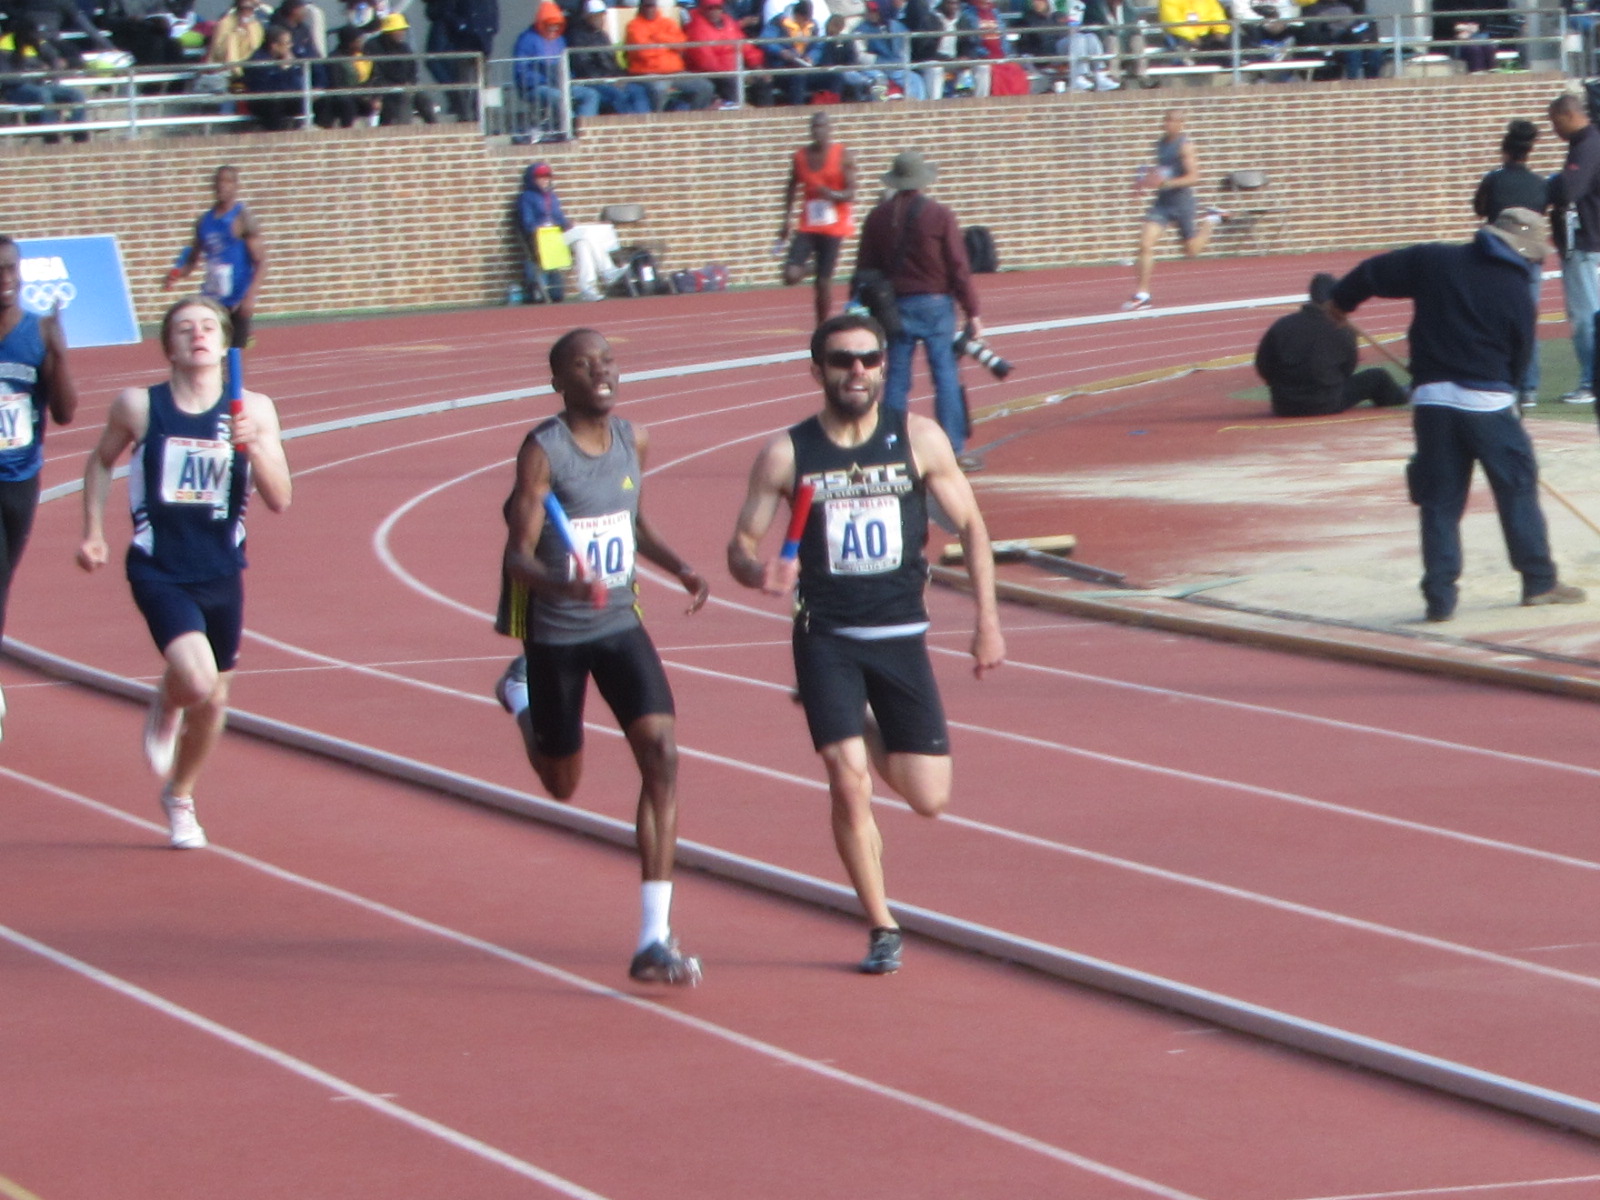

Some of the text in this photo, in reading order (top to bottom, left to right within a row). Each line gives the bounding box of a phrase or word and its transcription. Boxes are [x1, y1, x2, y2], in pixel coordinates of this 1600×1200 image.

[178, 456, 229, 491] AW
[829, 500, 855, 510] PENN
[573, 520, 599, 530] PENN
